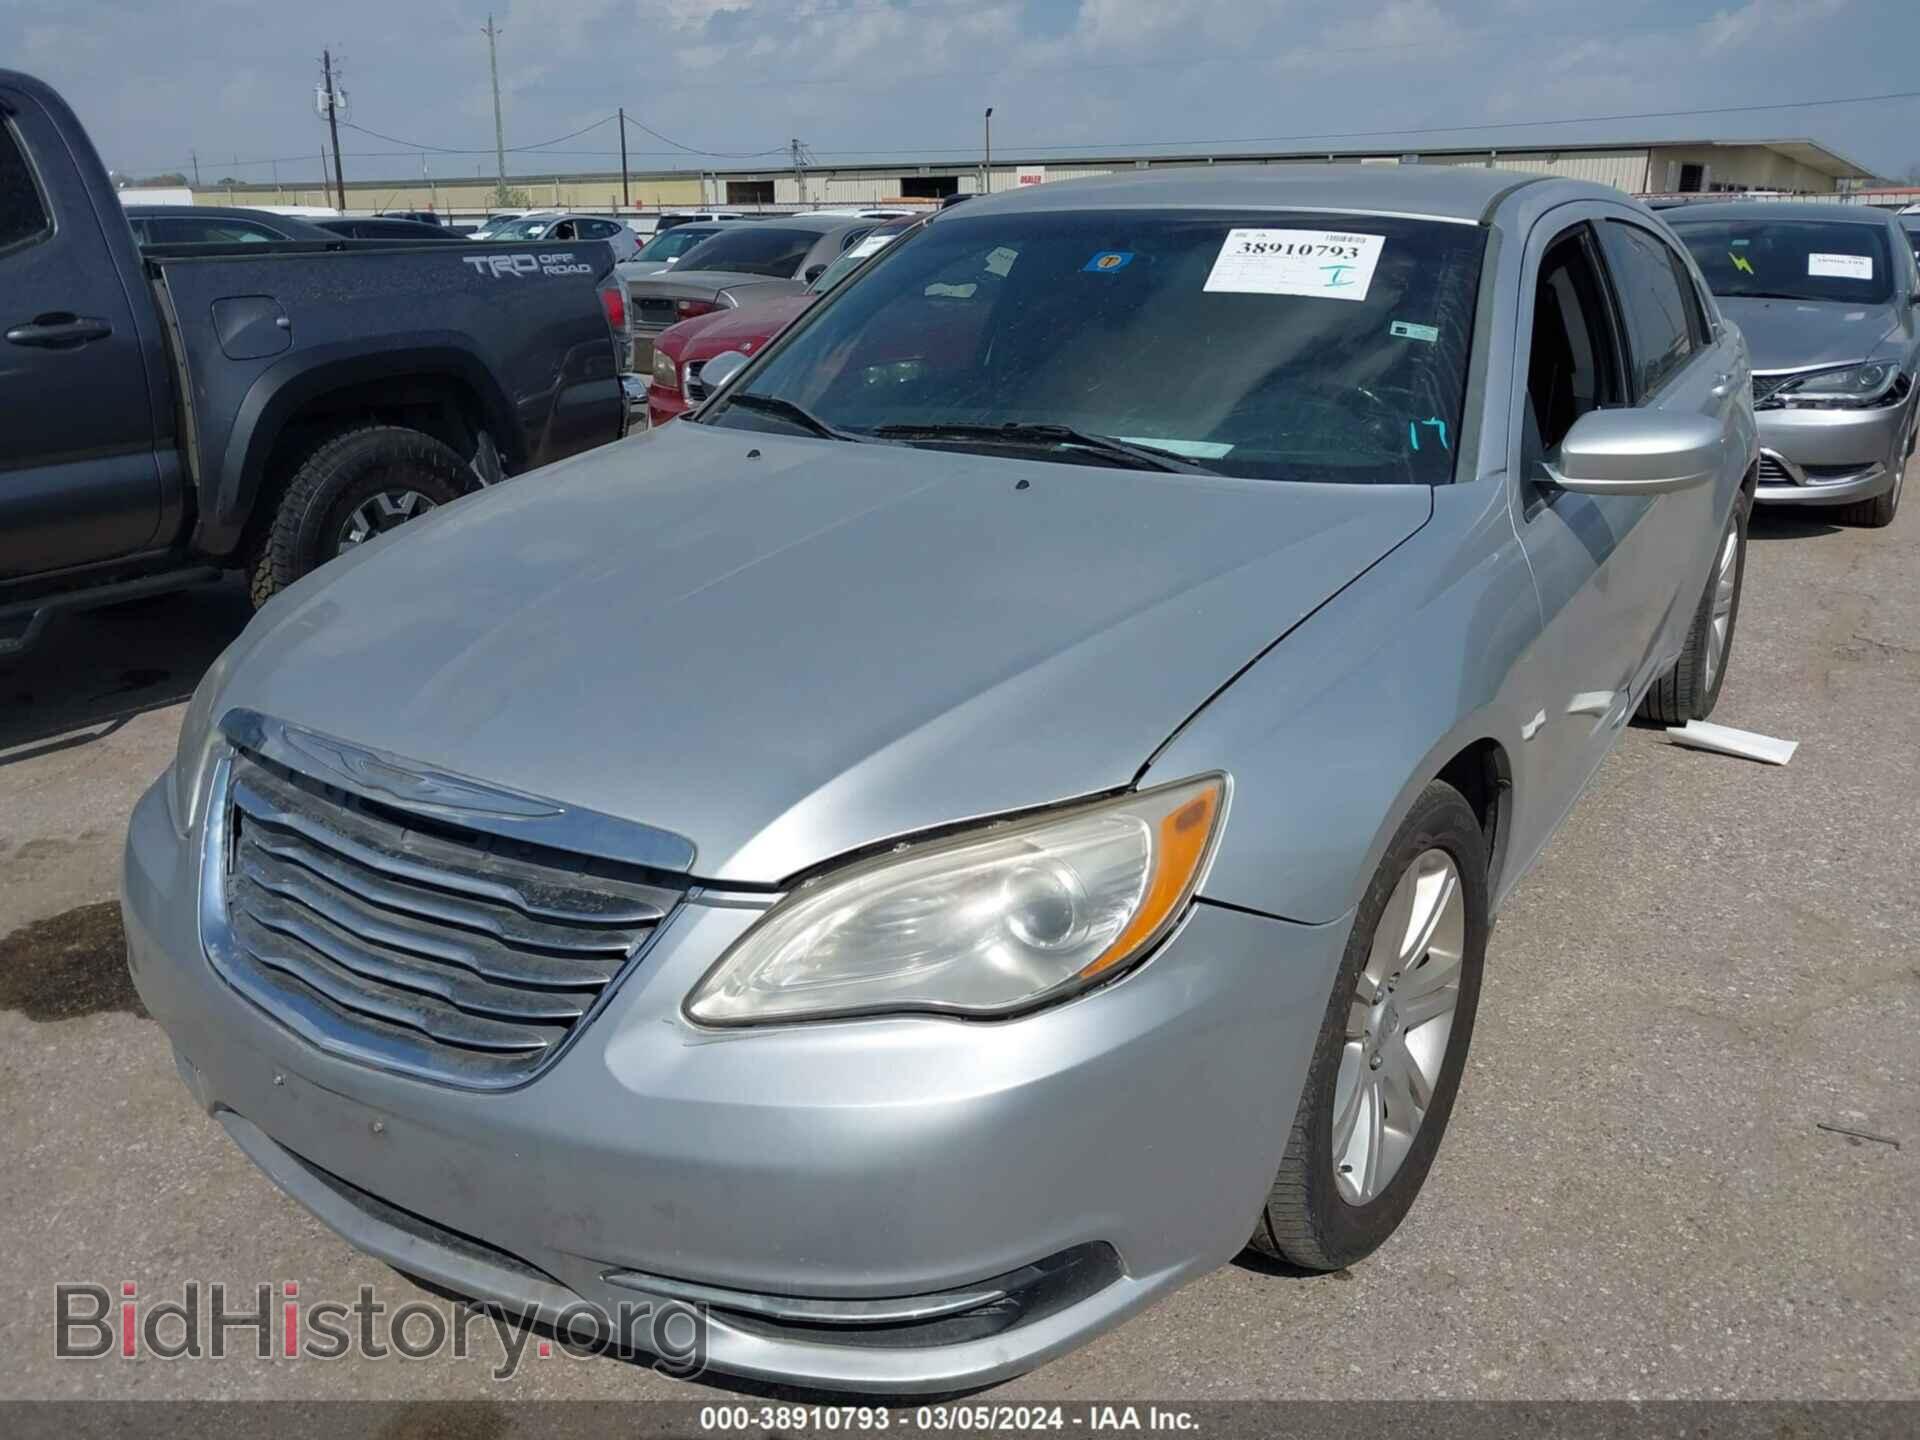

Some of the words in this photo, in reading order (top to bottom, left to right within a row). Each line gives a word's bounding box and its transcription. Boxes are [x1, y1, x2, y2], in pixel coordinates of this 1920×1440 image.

[1236, 241, 1358, 260] 38910793
[462, 254, 538, 278] TRD
[539, 253, 574, 263] OFF
[543, 264, 592, 274] ROAD
